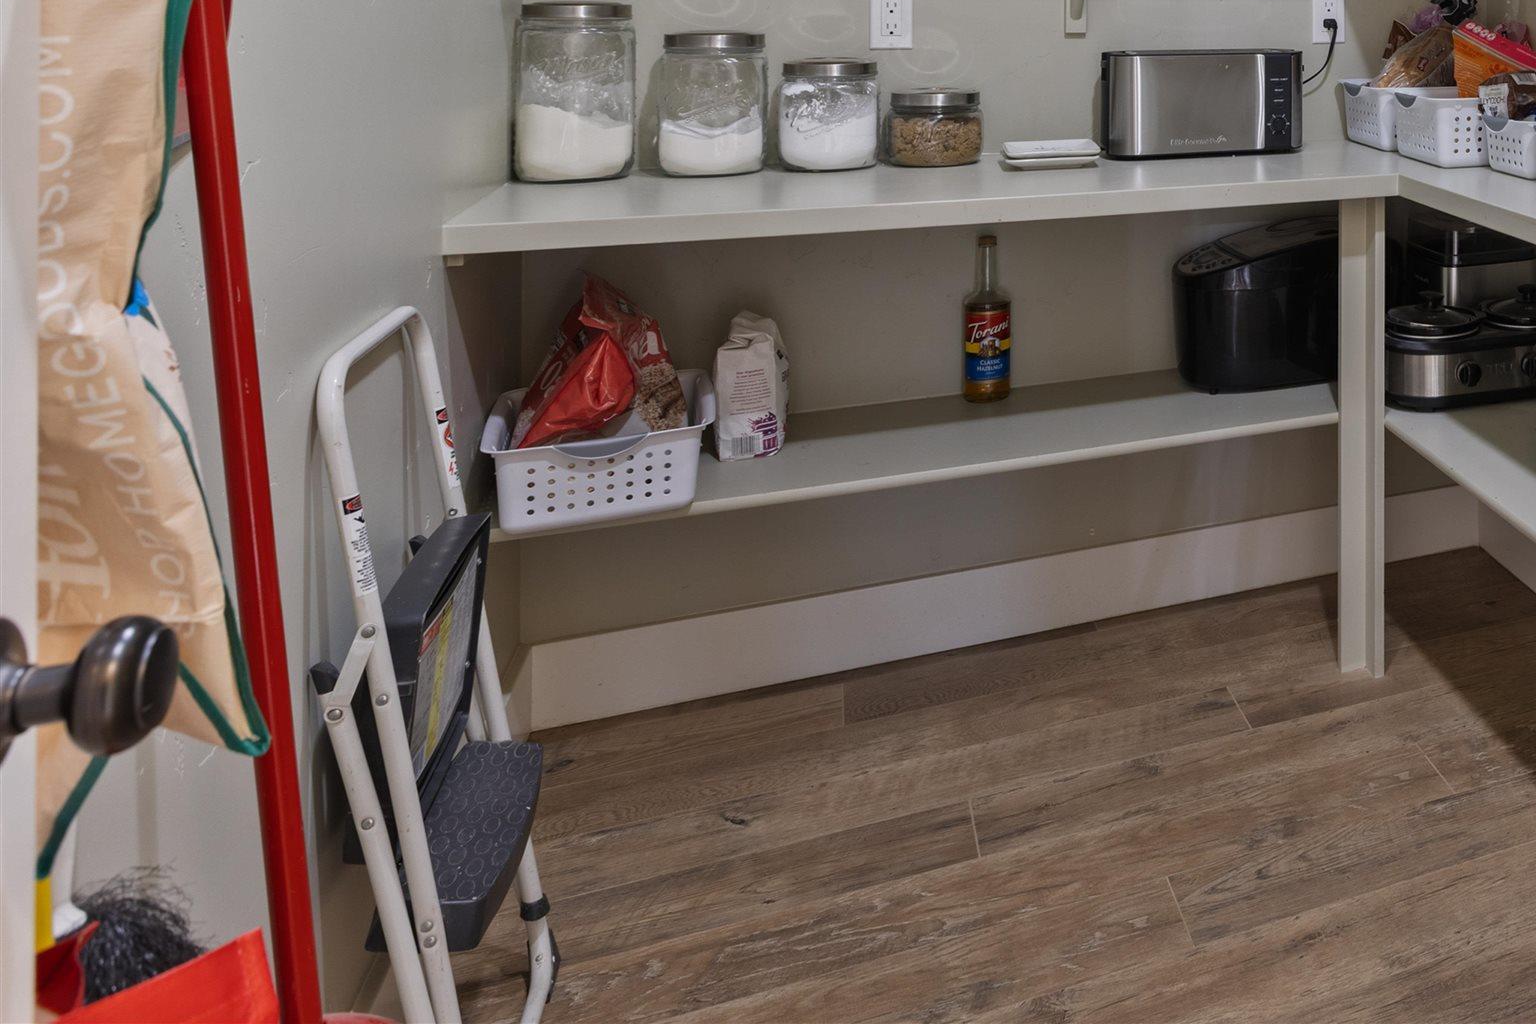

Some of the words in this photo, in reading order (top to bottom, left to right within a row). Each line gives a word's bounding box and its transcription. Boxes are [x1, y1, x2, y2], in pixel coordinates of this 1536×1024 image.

[968, 319, 1010, 343] Torani
[979, 359, 1002, 367] CLASSIC
[976, 364, 1003, 373] HAZELNUT
